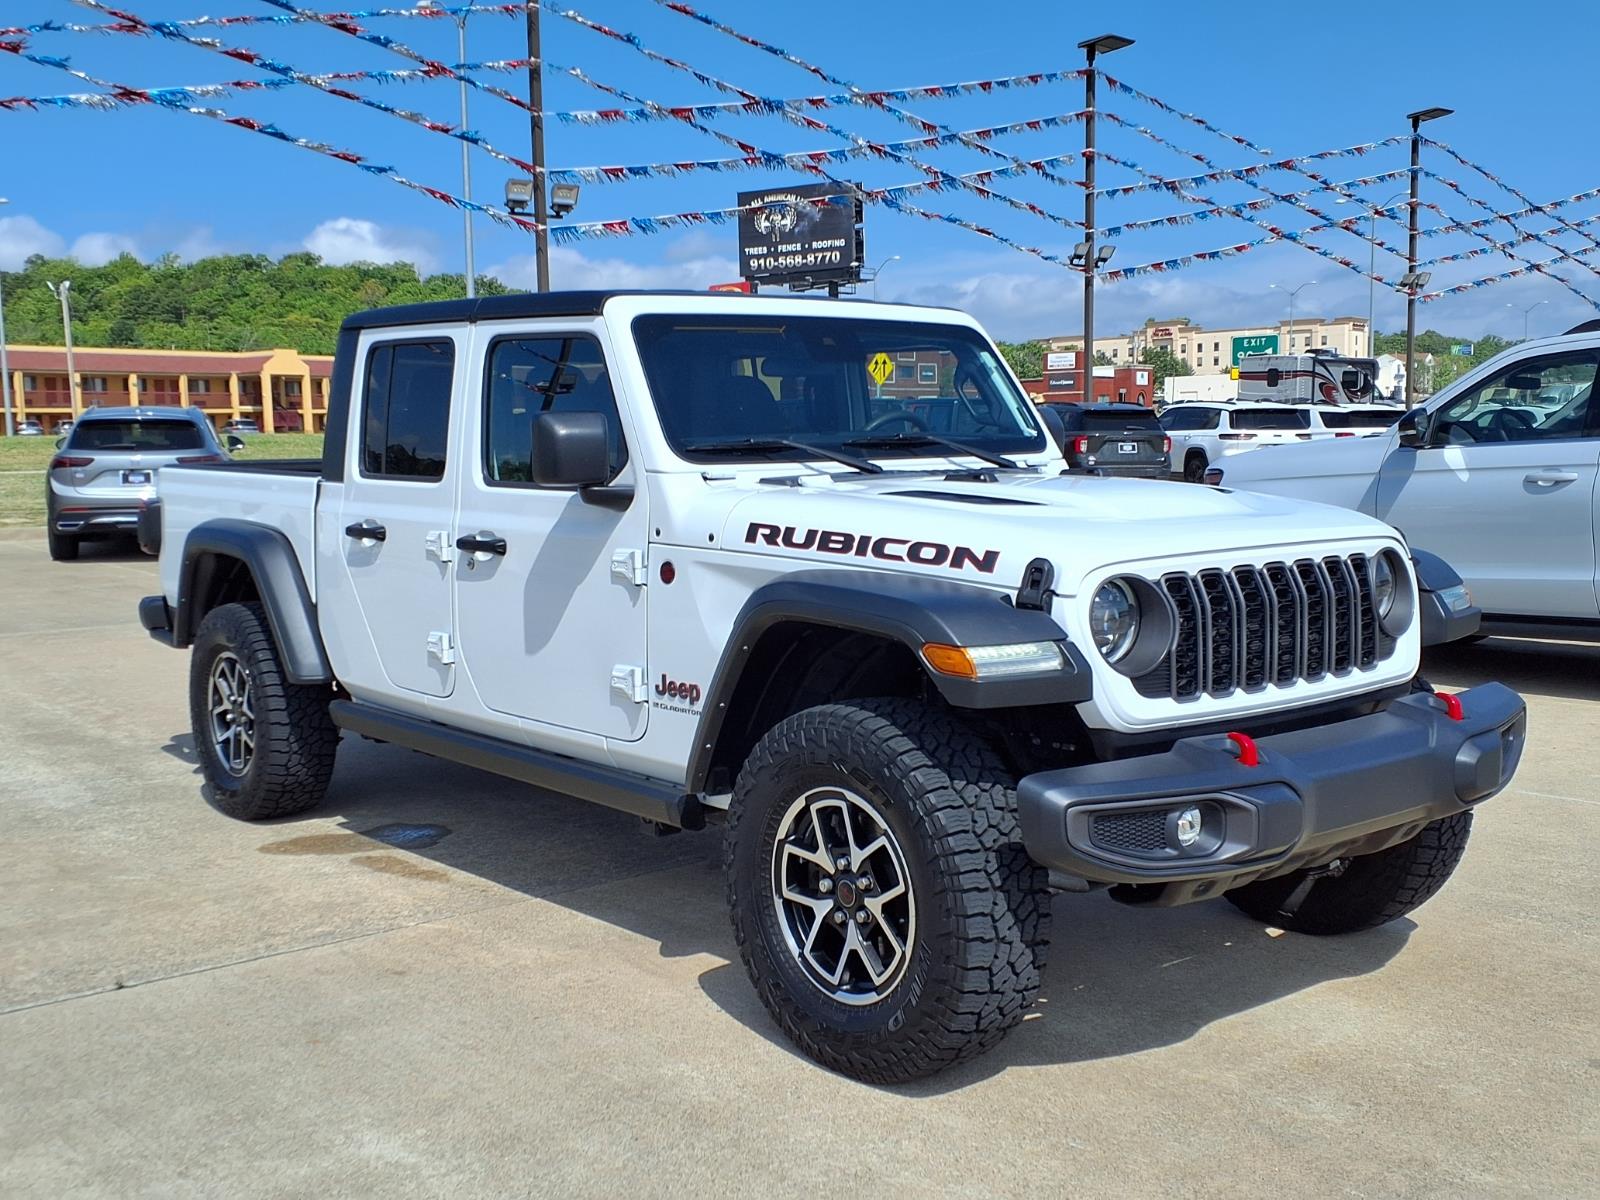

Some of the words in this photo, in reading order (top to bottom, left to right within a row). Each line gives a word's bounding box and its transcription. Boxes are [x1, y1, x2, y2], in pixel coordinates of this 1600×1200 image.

[751, 197, 763, 208] ALL
[744, 246, 768, 256] TREES
[777, 242, 802, 253] FENCE
[812, 238, 846, 250] ROOFING
[749, 250, 841, 271] 910-568-8770
[1243, 337, 1267, 347] EXIT
[744, 522, 1001, 574] RUBICON
[654, 673, 701, 706] Jeep
